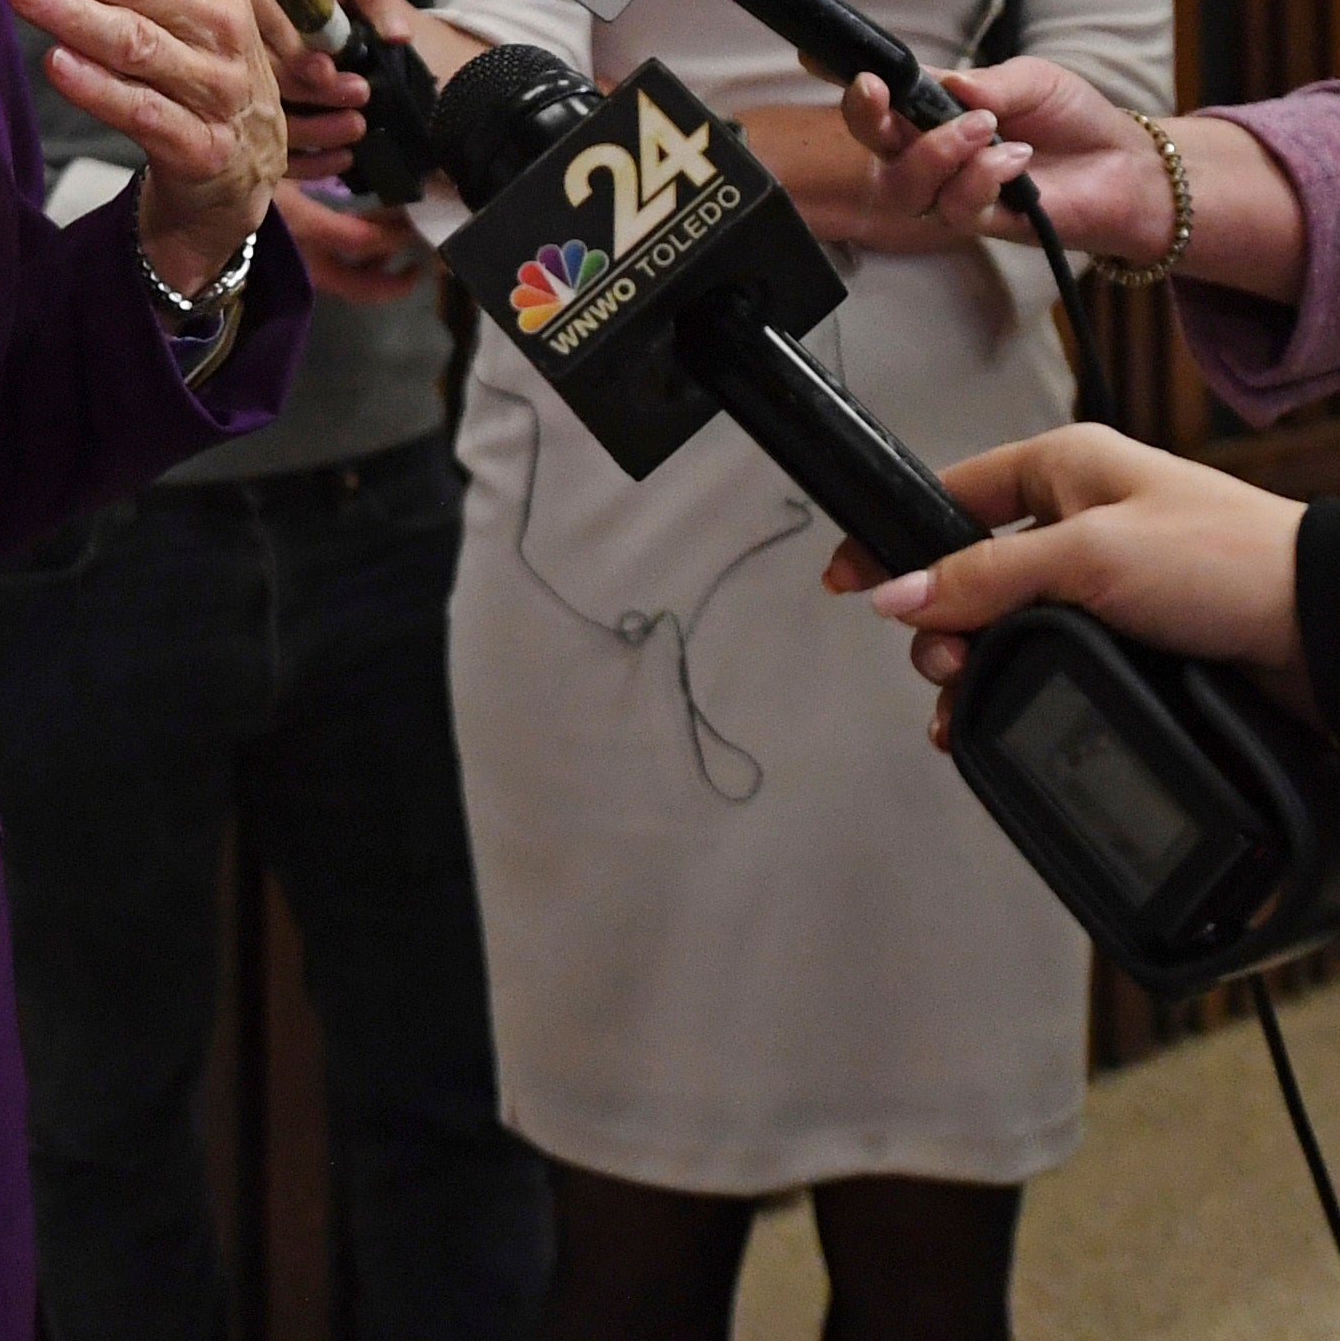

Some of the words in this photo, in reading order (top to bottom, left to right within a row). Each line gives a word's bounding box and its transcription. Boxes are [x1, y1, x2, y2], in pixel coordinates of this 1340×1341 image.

[564, 89, 710, 260] 24
[550, 278, 637, 356] WNWO
[635, 183, 742, 279] TOLEDO
